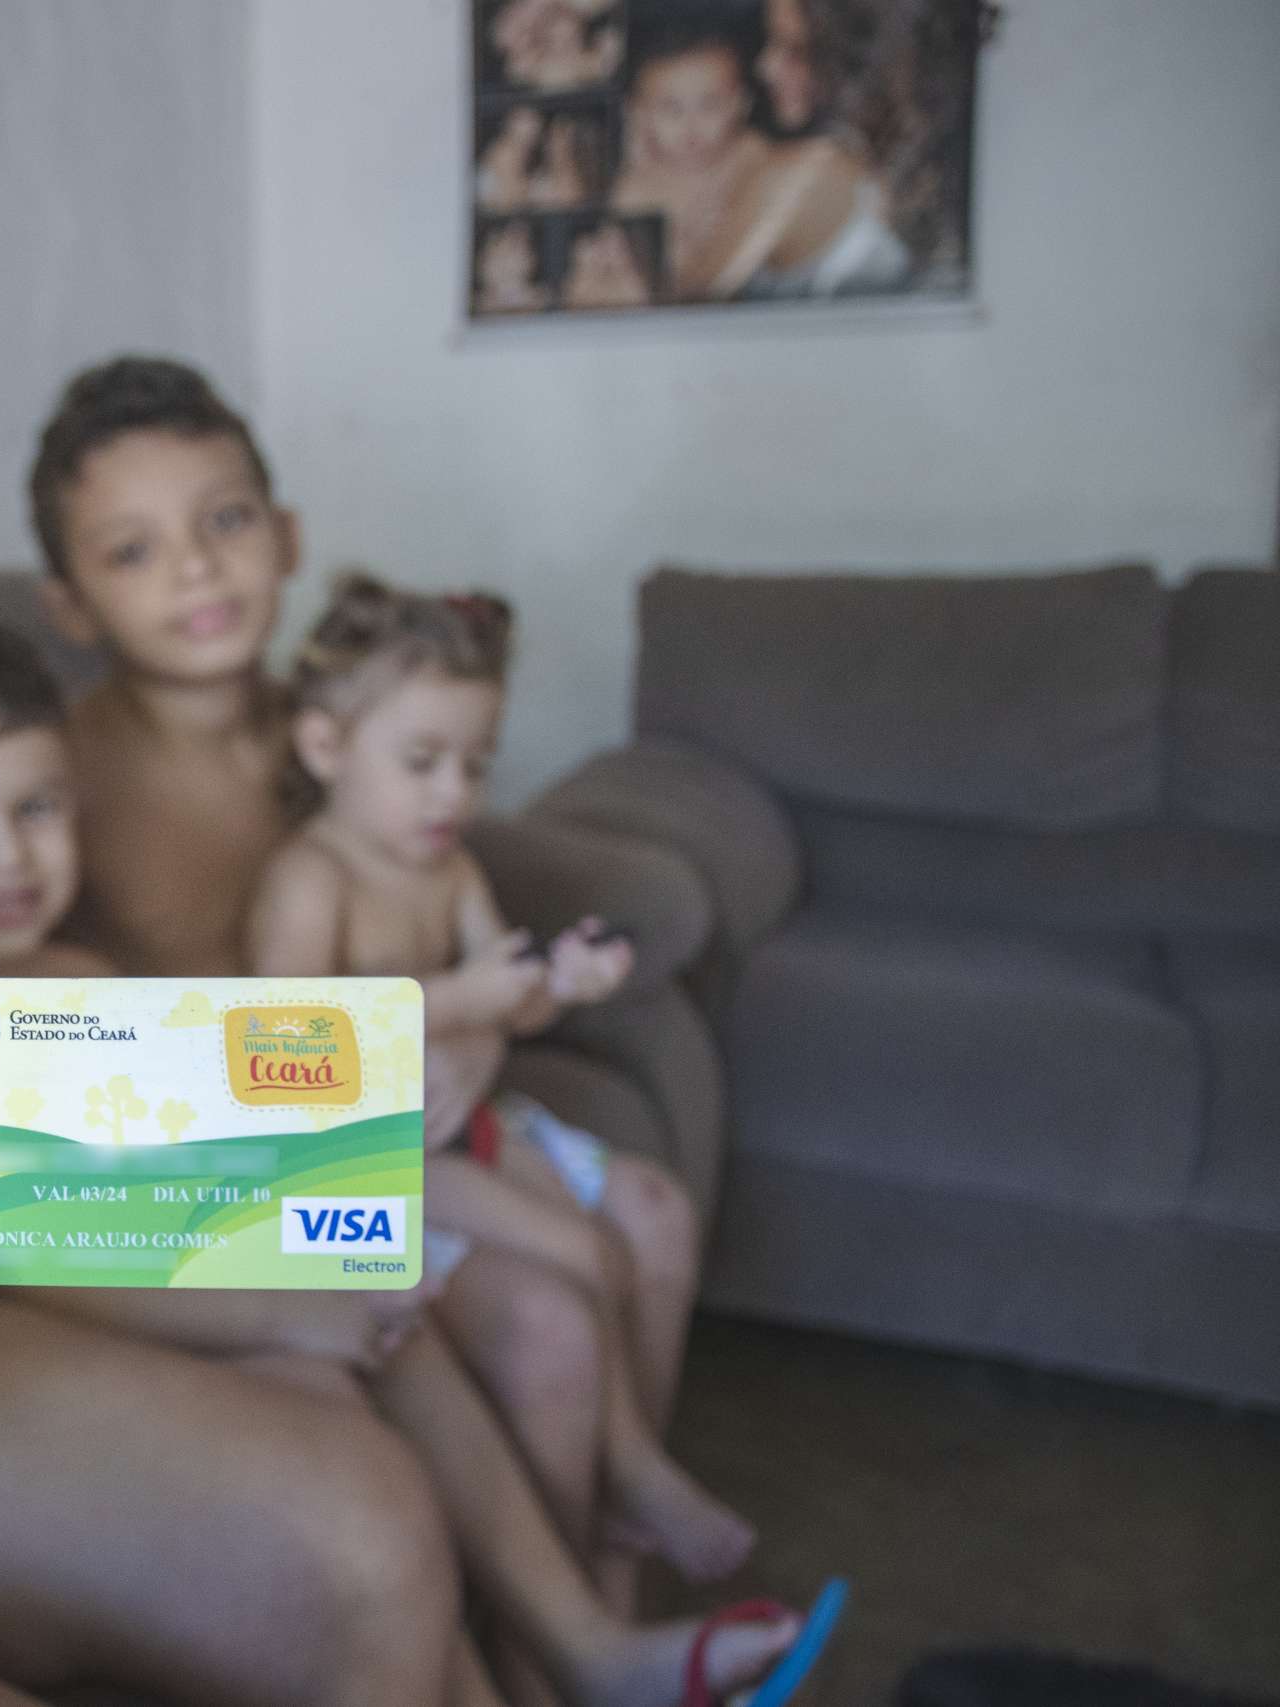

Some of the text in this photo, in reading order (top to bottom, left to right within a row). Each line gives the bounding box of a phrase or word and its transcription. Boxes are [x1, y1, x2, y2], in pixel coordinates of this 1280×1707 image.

[9, 1009, 81, 1025] GOVERNO
[10, 1026, 66, 1041] ESTADO
[87, 1026, 137, 1041] CEARÁ
[250, 1054, 334, 1085] Ceará
[32, 1185, 75, 1201] VAL
[80, 1186, 128, 1202] 03/24
[153, 1186, 191, 1202] DIA
[252, 1187, 271, 1202] 10
[291, 1209, 393, 1242] VISA
[61, 1231, 148, 1249] ARAUJO
[151, 1232, 231, 1249] GOMES
[343, 1259, 407, 1273] Electron
